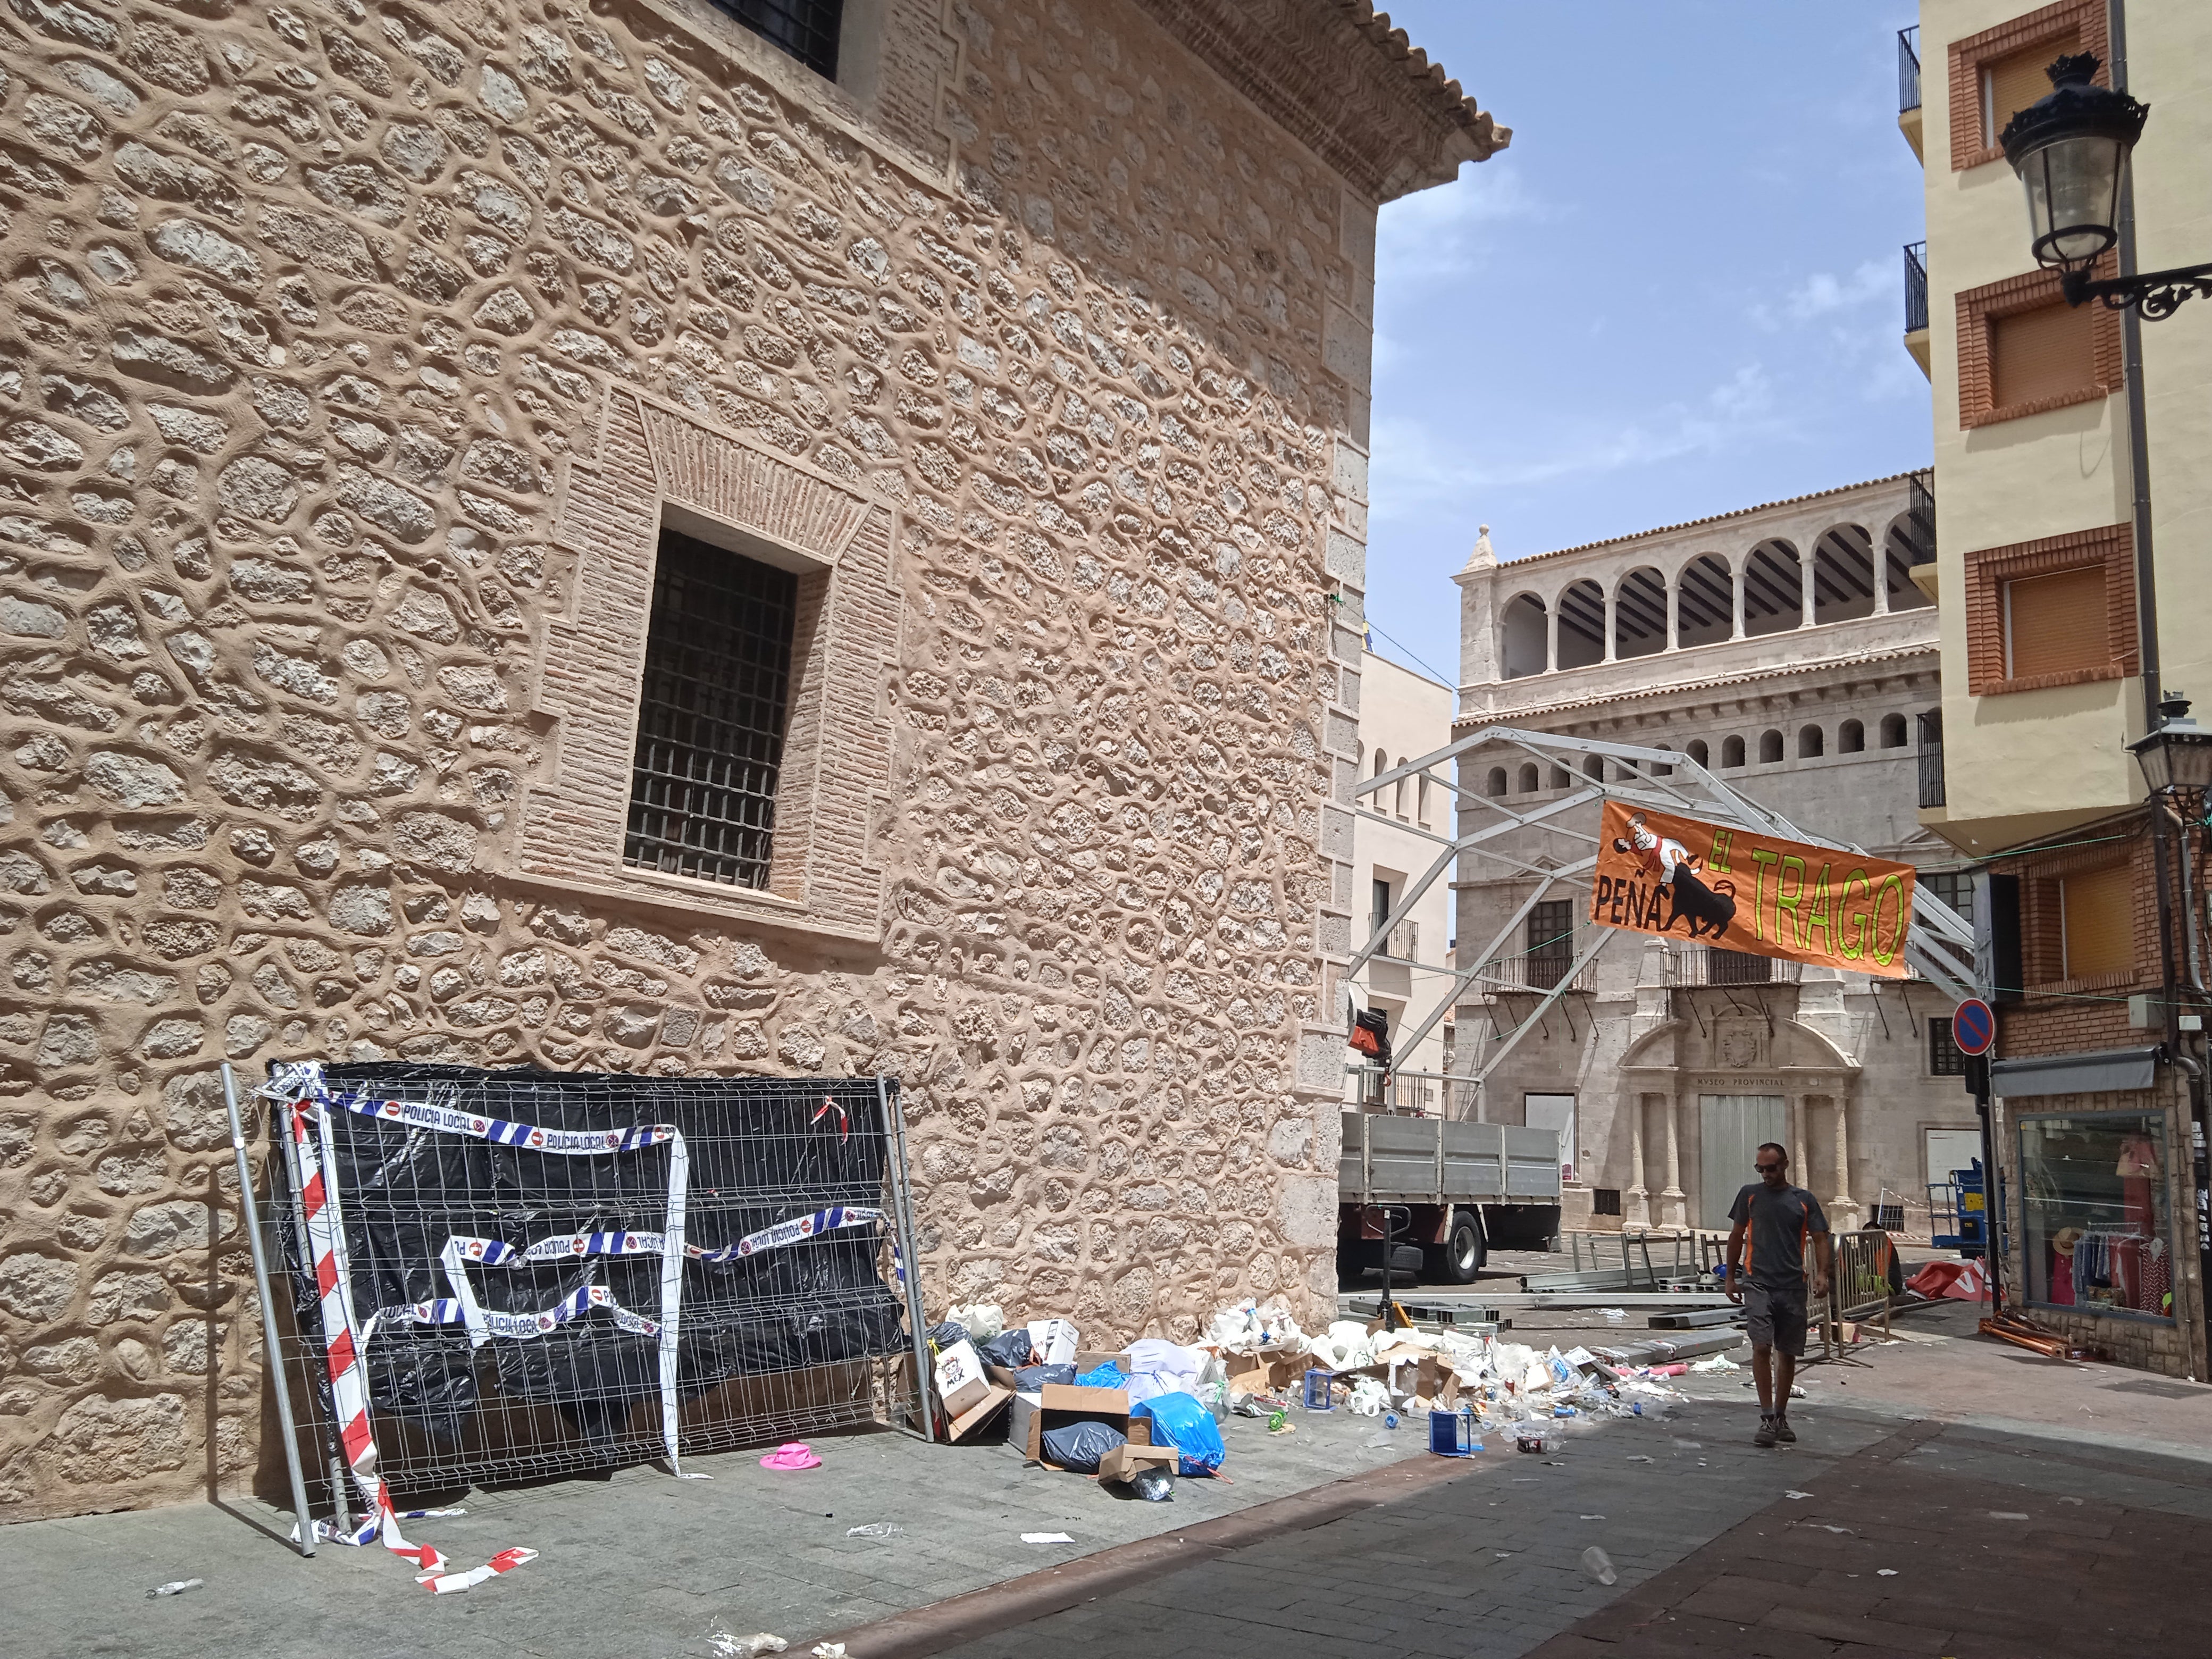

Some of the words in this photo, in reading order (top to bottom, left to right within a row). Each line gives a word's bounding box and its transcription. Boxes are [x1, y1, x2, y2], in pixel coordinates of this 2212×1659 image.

[1595, 869, 1662, 932] PEÑA
[1708, 830, 1733, 874] EL
[1751, 848, 1904, 967] TRAGO
[404, 1104, 440, 1125] POLICIA
[443, 1112, 472, 1130] LOCAL
[547, 1133, 580, 1150] POLICIA
[580, 1136, 606, 1150] LOCAL
[946, 1368, 965, 1389] MEX
